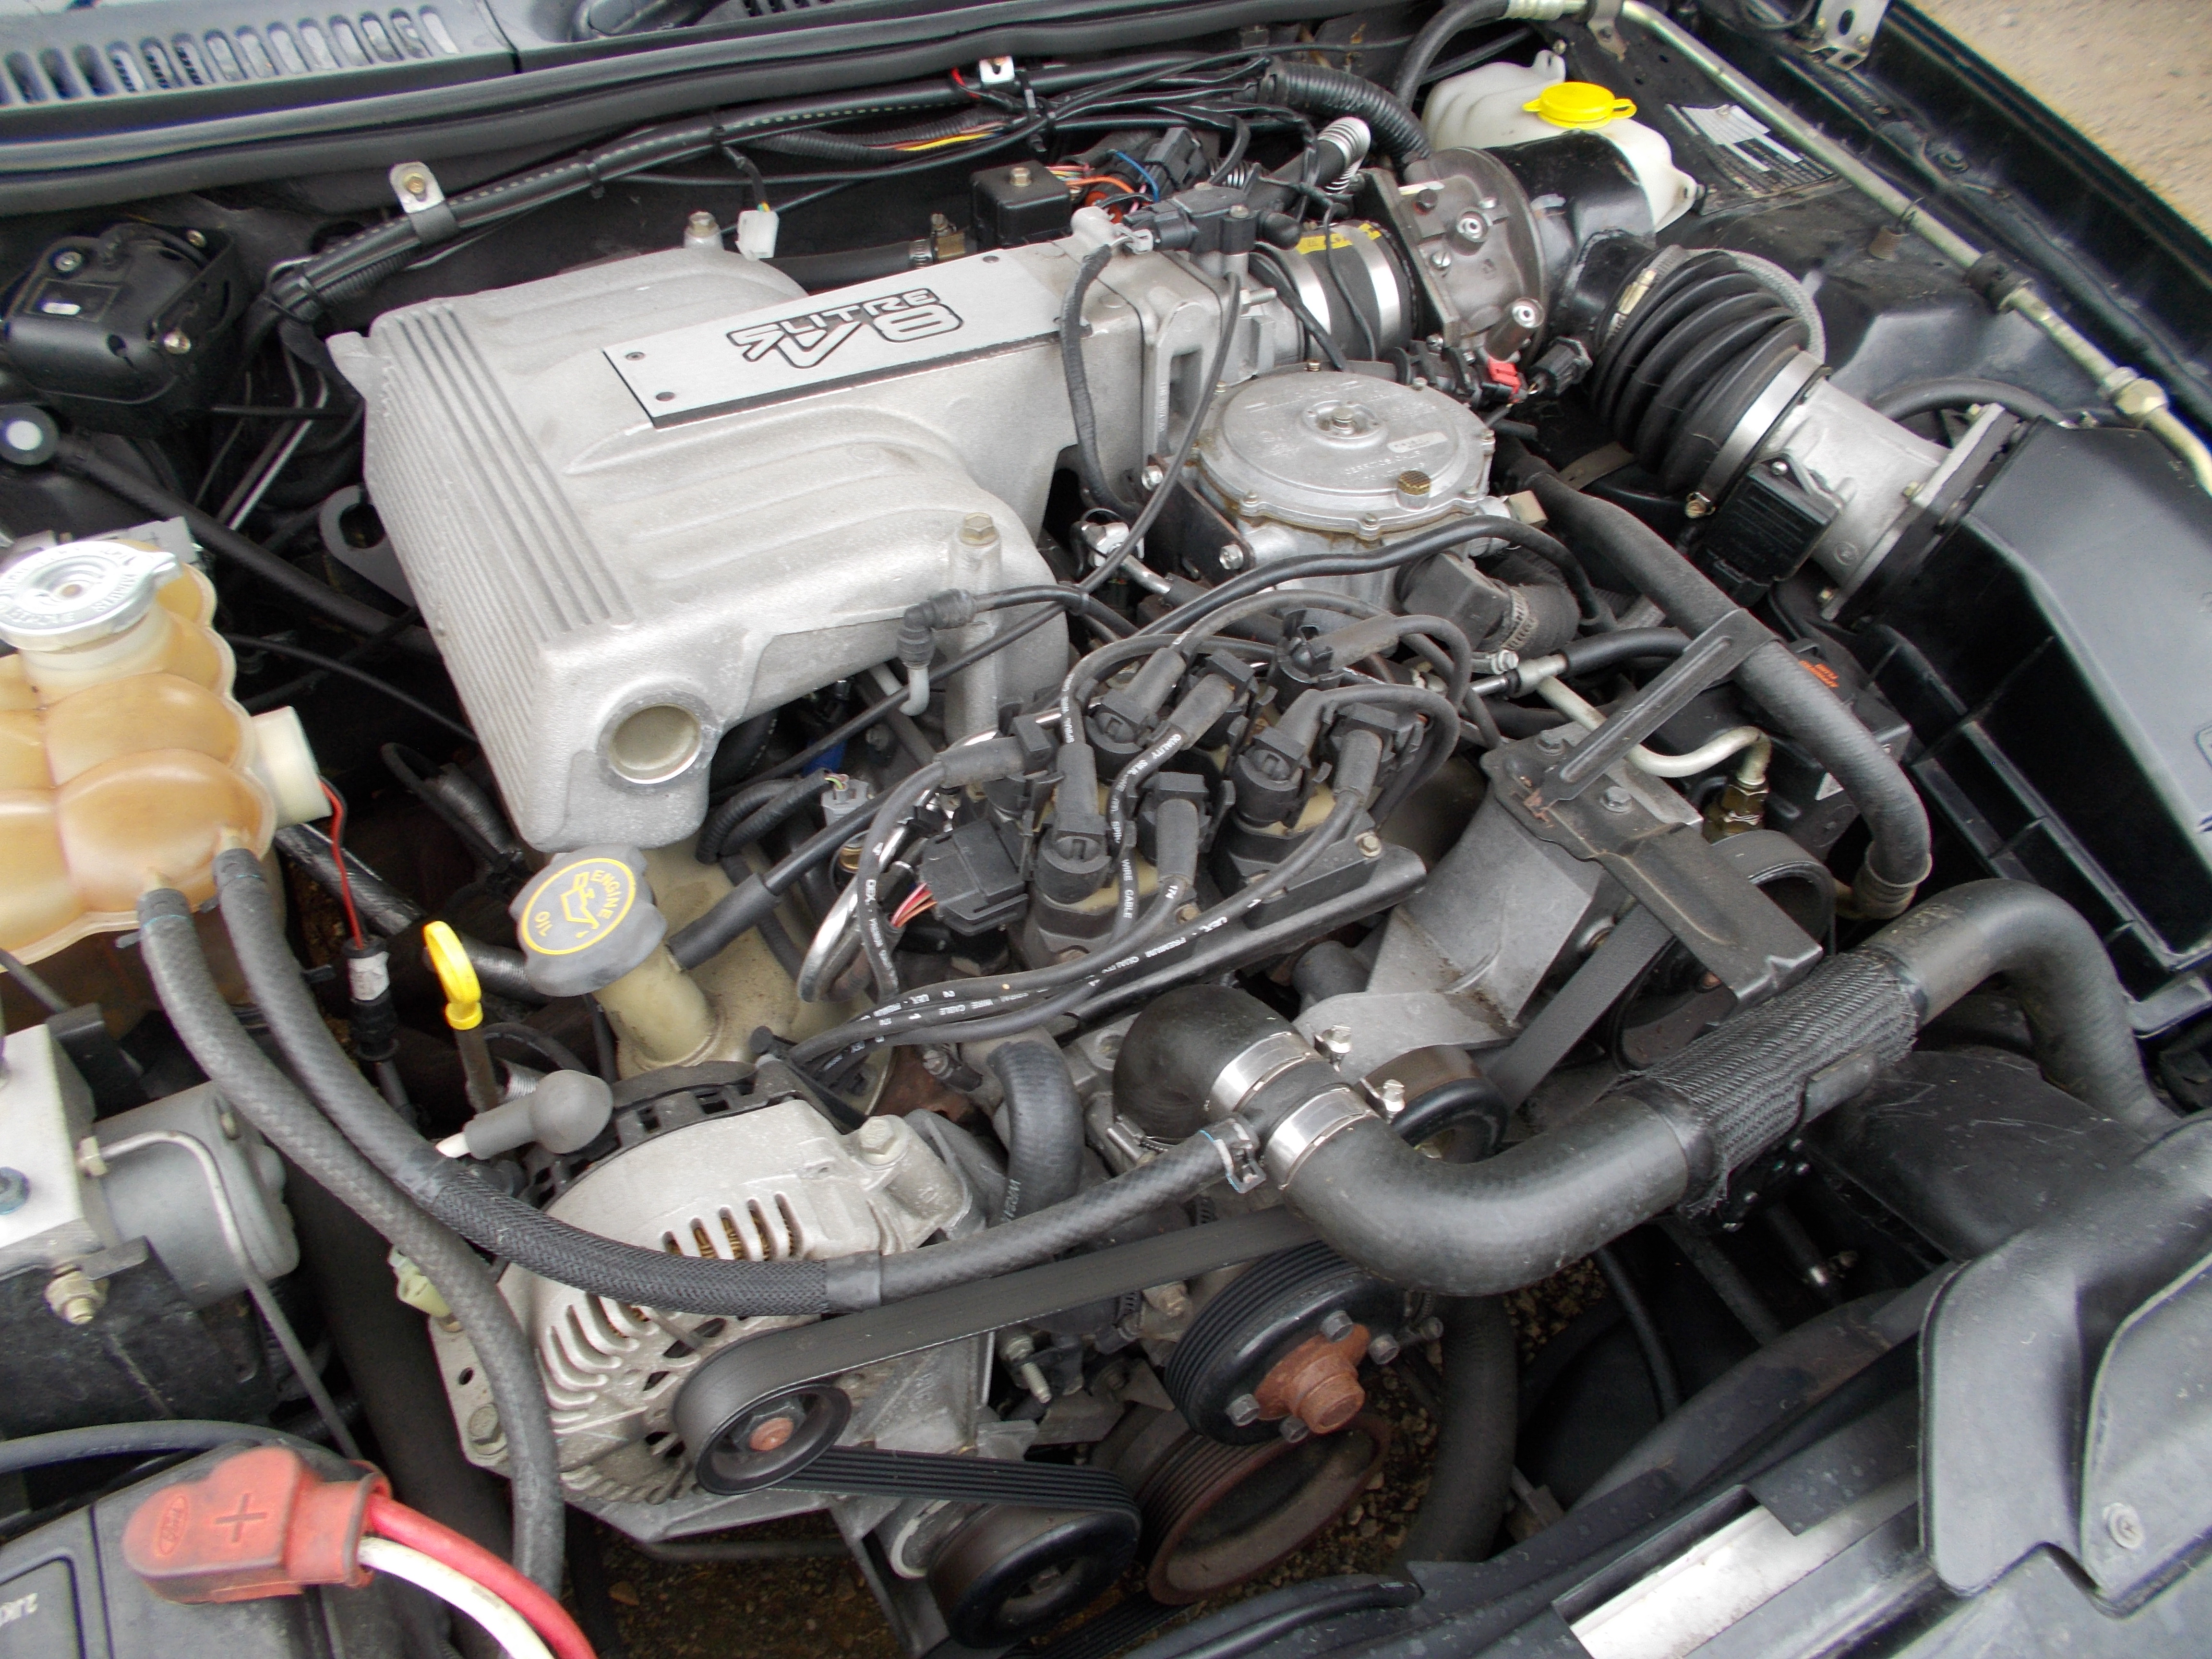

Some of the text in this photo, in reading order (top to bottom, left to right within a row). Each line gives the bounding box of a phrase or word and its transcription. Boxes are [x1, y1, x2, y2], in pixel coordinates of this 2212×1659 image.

[777, 303, 963, 369] V8
[1121, 859, 1133, 881] WIRE
[590, 870, 622, 919] ENGINE
[1123, 890, 1134, 919] CABLE
[533, 911, 553, 937] OIL
[1145, 937, 1187, 958] PREMIUM
[939, 1004, 966, 1015] CABLE
